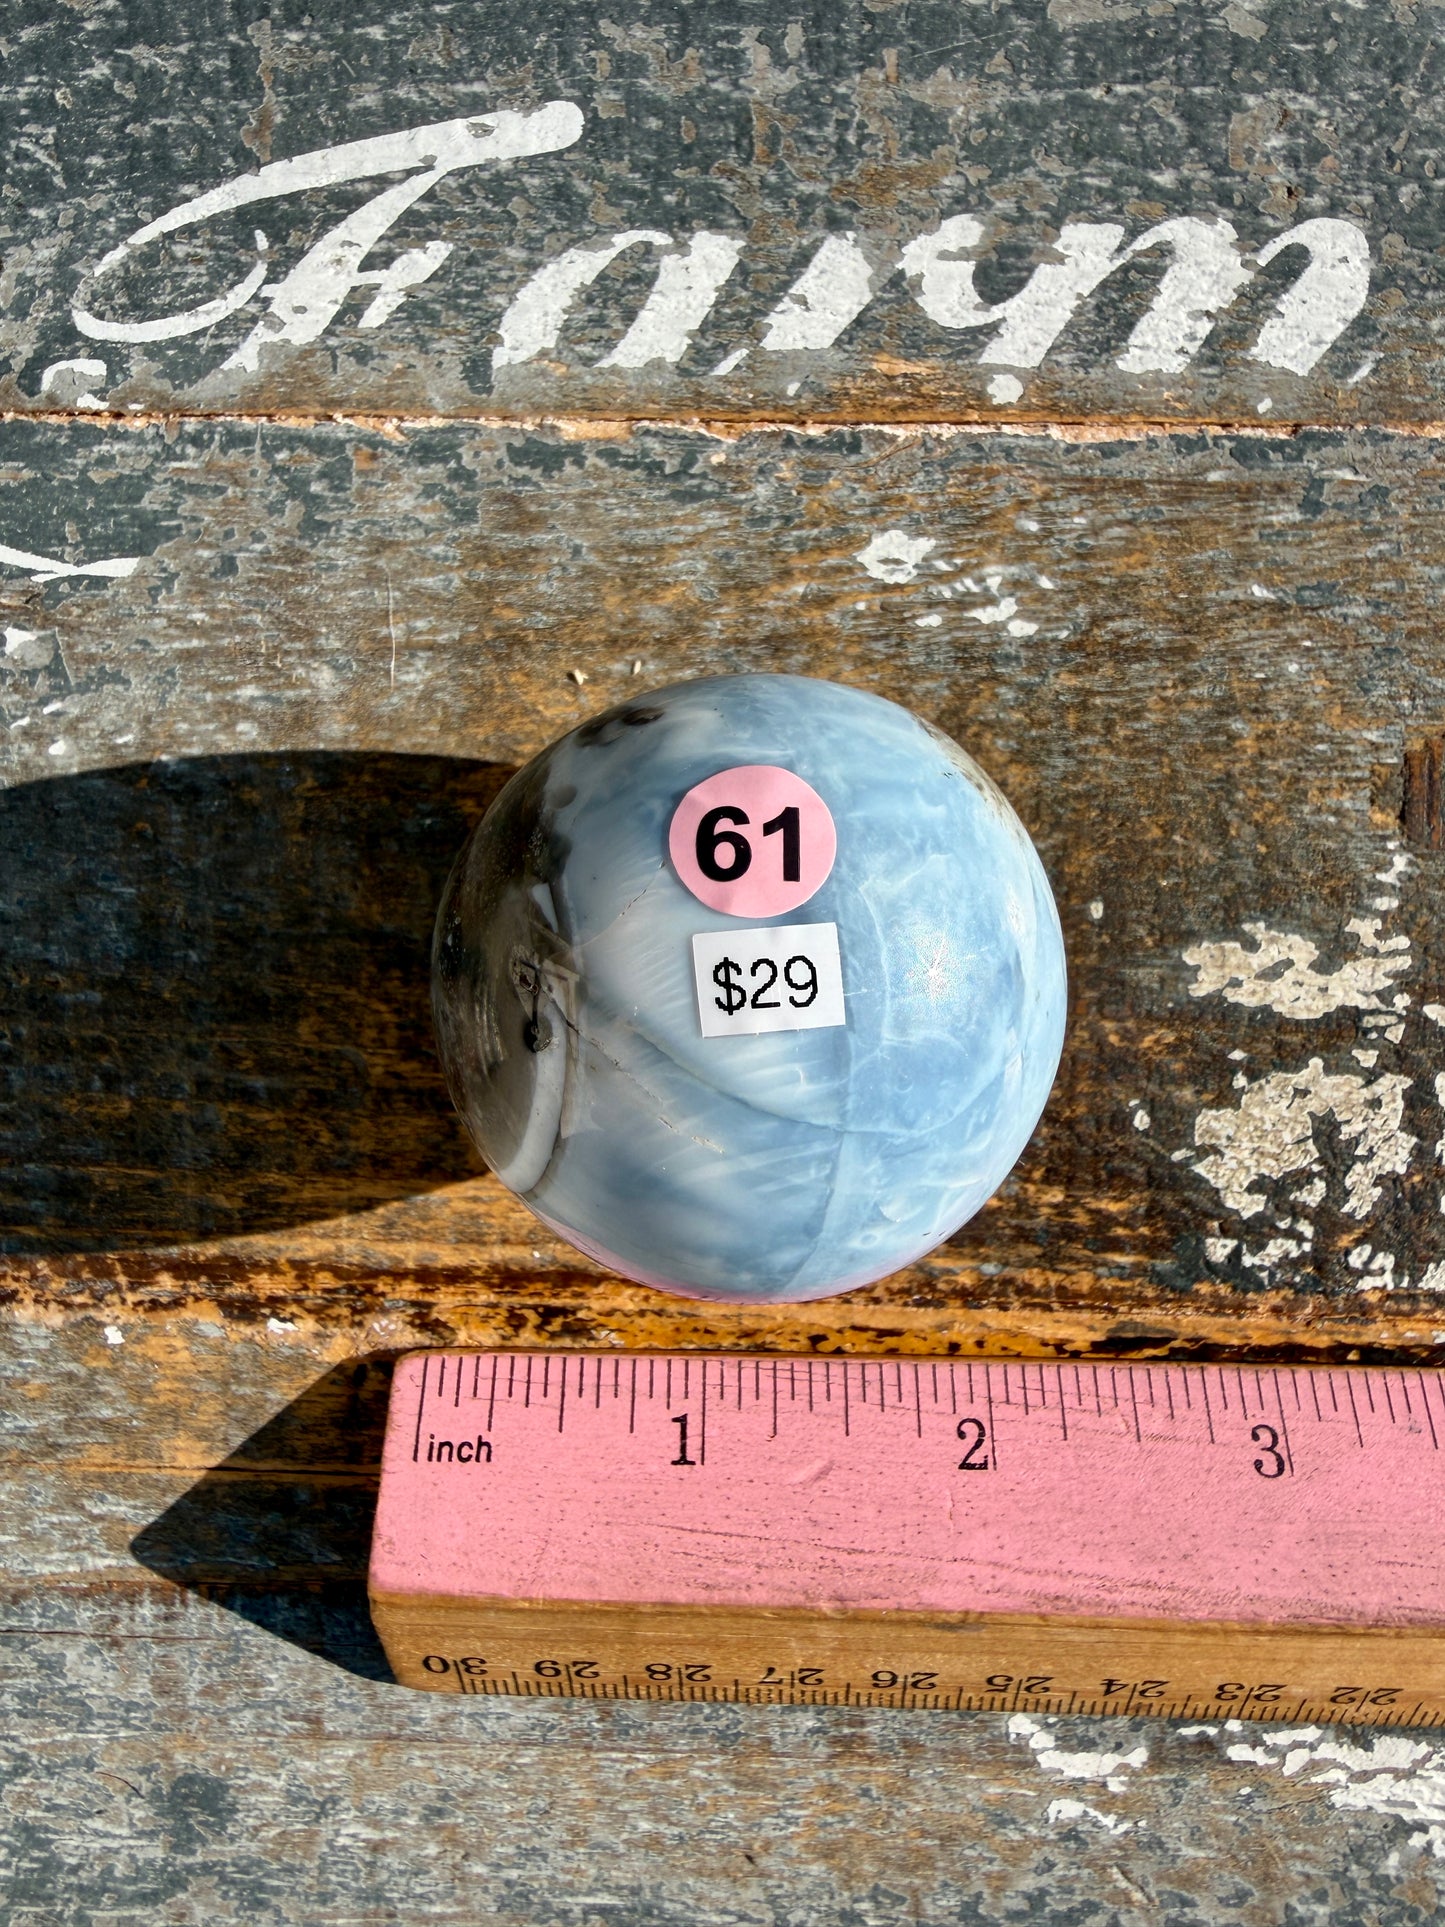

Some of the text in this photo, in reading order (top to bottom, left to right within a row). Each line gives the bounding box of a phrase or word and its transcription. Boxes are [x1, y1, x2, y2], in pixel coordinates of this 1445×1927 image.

[694, 805, 801, 882] 61
[712, 954, 819, 1016] $29
[426, 1413, 1286, 1479] inch 1 2 3
[421, 1655, 1405, 1707] 22 23 24 25 26 27 28 29 30
